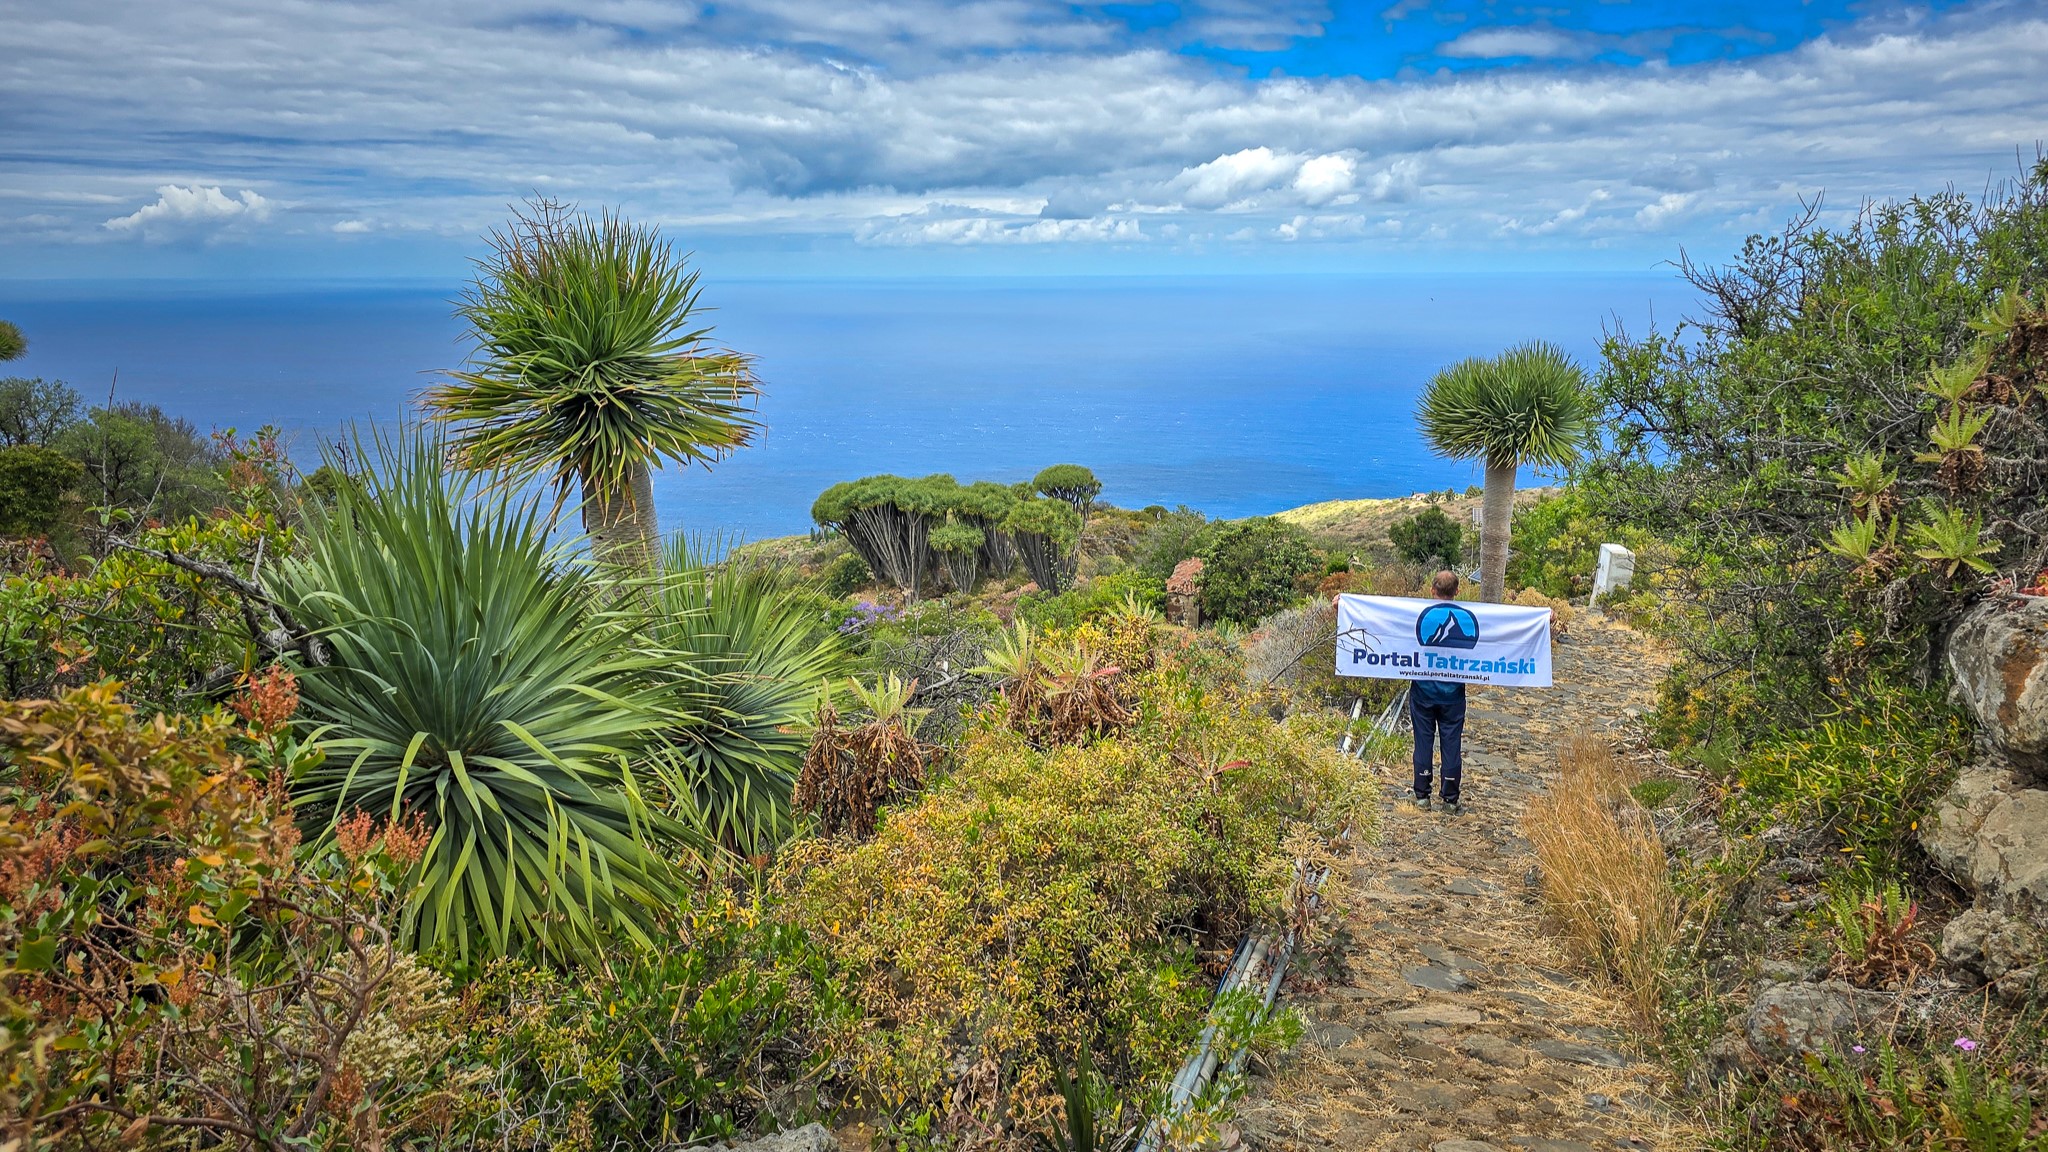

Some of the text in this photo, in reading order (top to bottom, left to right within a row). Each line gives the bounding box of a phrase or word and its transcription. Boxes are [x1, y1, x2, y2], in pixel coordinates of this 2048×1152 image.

[1353, 648, 1536, 675] Portal Tatrzański
[1399, 670, 1490, 681] wycieczki.portaltatrzanski.pl
